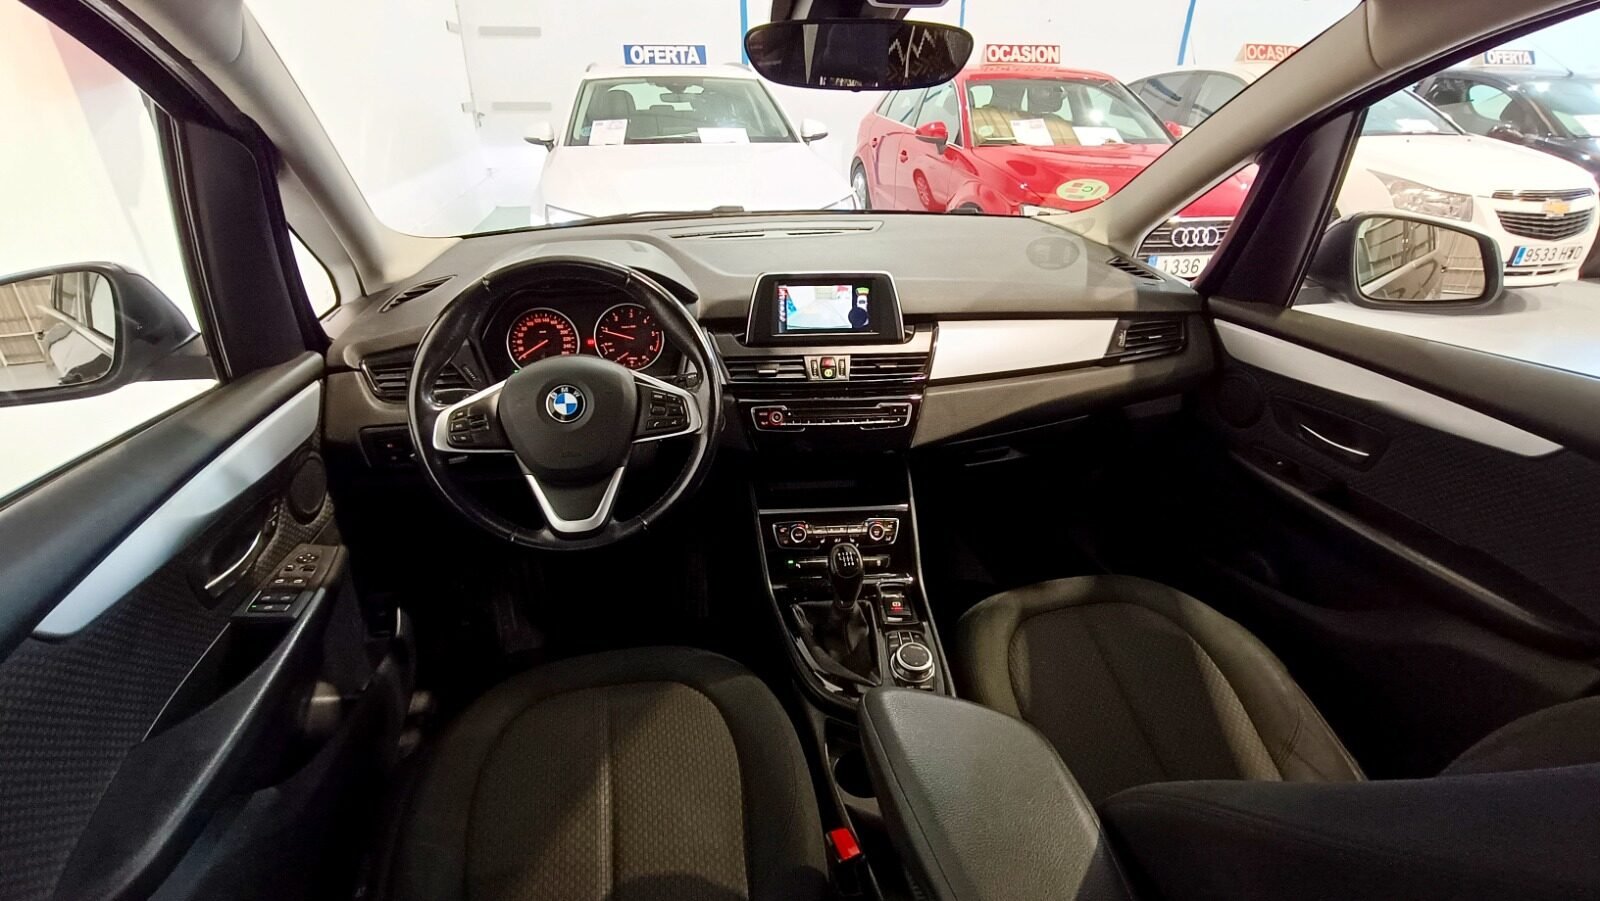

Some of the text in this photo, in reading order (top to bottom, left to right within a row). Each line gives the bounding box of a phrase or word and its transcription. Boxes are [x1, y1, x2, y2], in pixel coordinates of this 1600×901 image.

[629, 45, 701, 65] OFERTA
[986, 44, 1060, 64] OCASION
[1486, 50, 1534, 65] OFERTA
[1524, 246, 1558, 262] 9533
[1163, 257, 1201, 275] 1336
